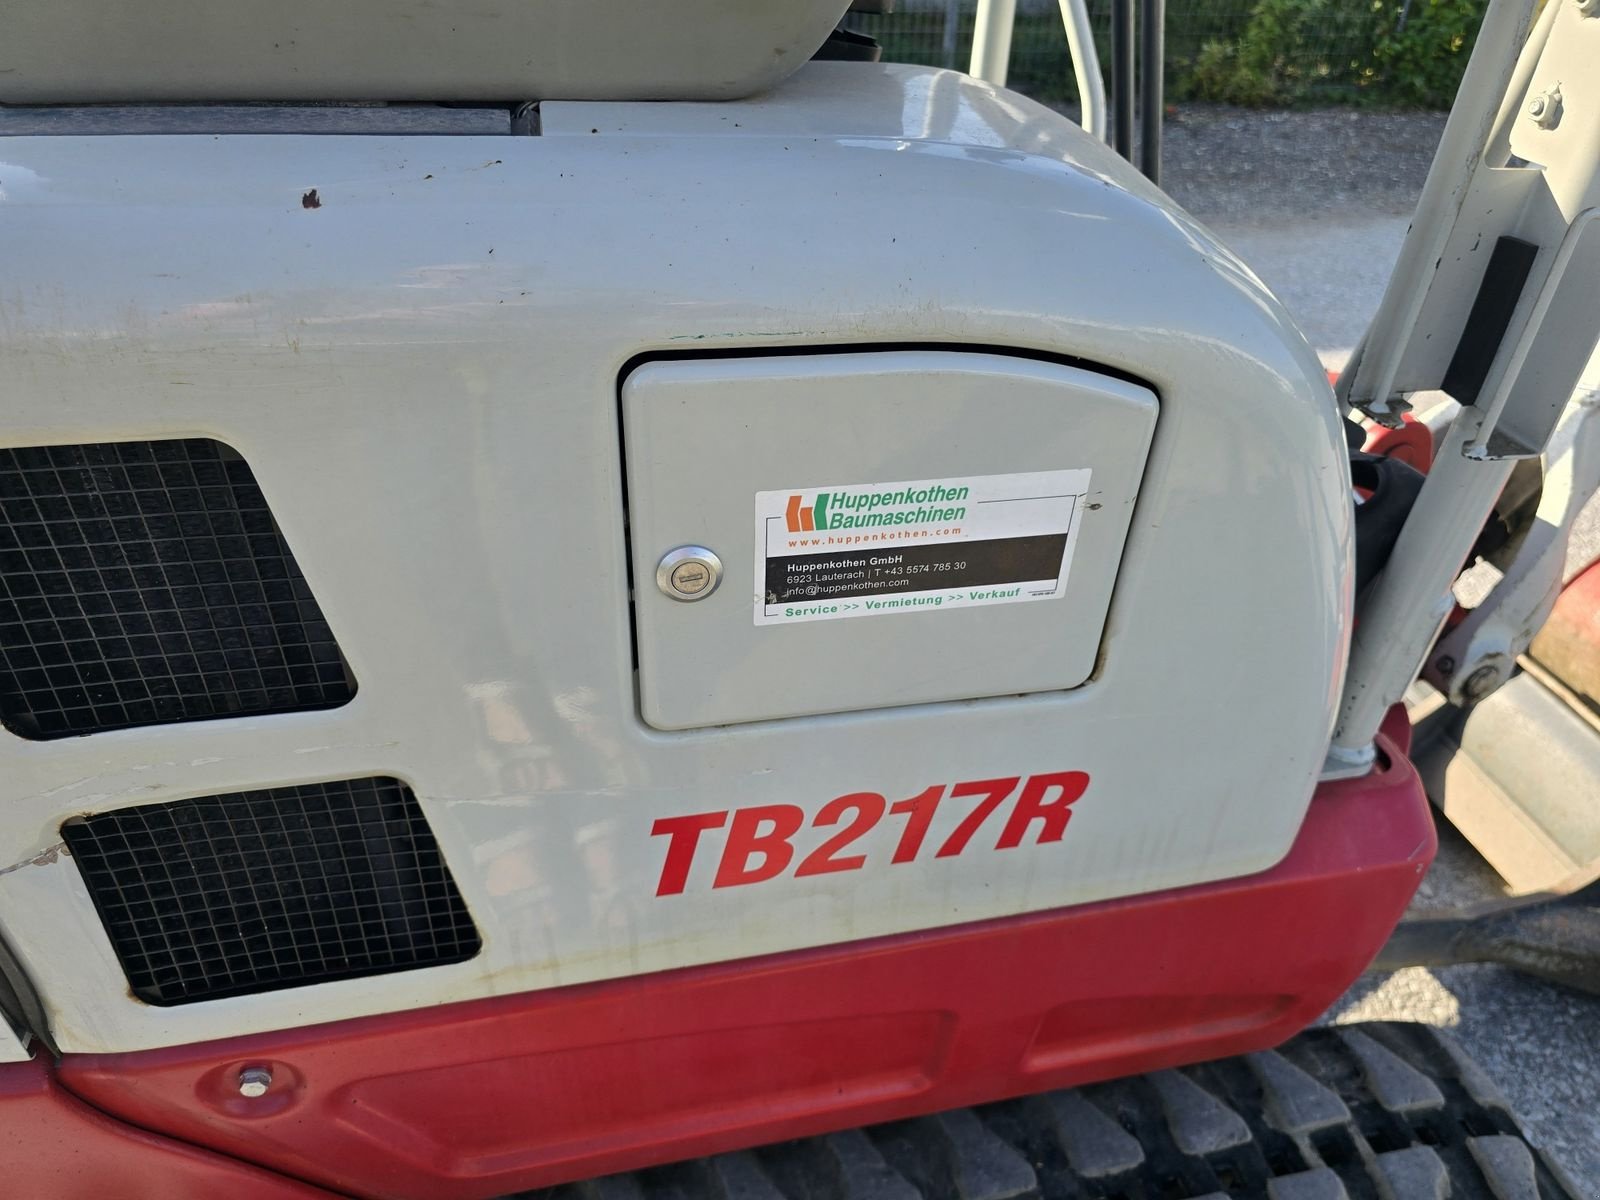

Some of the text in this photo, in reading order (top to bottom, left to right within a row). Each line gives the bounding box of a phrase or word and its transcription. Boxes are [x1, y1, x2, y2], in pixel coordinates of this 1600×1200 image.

[830, 485, 969, 513] Huppenkothen
[829, 506, 966, 530] Baumaschinen
[788, 527, 962, 548] www.huppenkothen.com
[786, 575, 812, 584] 6923
[815, 570, 865, 582] Lauterach
[874, 568, 881, 577] T
[884, 565, 903, 575] +43
[906, 564, 929, 574] 5574
[933, 562, 951, 572] 785
[953, 561, 967, 570] 30
[787, 555, 903, 573] Huppenkothen GmbH
[786, 578, 909, 596] info@huppenkothen.com
[785, 604, 838, 617] Service
[866, 596, 943, 610] Vermietung
[969, 588, 1022, 601] Verkauf
[650, 770, 1091, 897] TB217R
